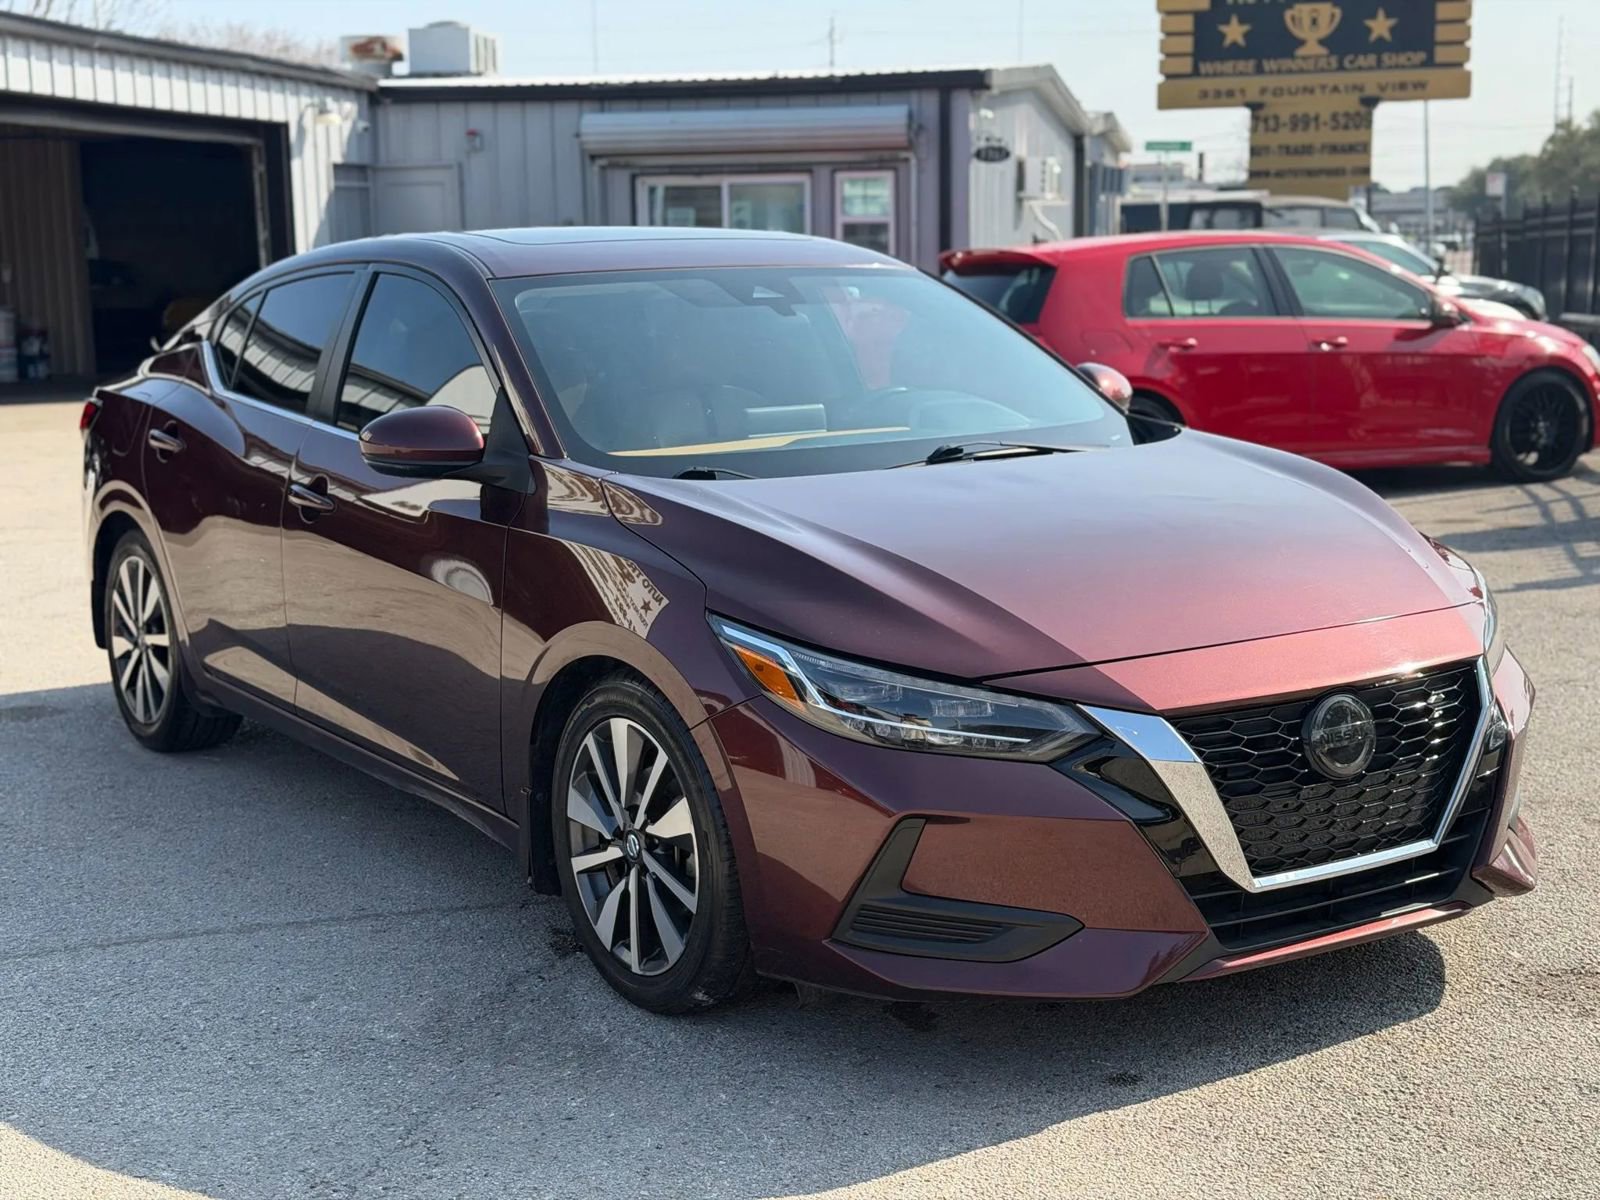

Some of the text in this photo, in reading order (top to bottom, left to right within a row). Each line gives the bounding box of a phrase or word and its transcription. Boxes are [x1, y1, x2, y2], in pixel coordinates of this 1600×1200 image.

[1263, 55, 1338, 73] WINNERS
[1343, 54, 1377, 69] CAR
[1381, 51, 1427, 67] SHOP
[1259, 83, 1365, 98] FOUNTAIN
[1376, 80, 1429, 93] VIEW
